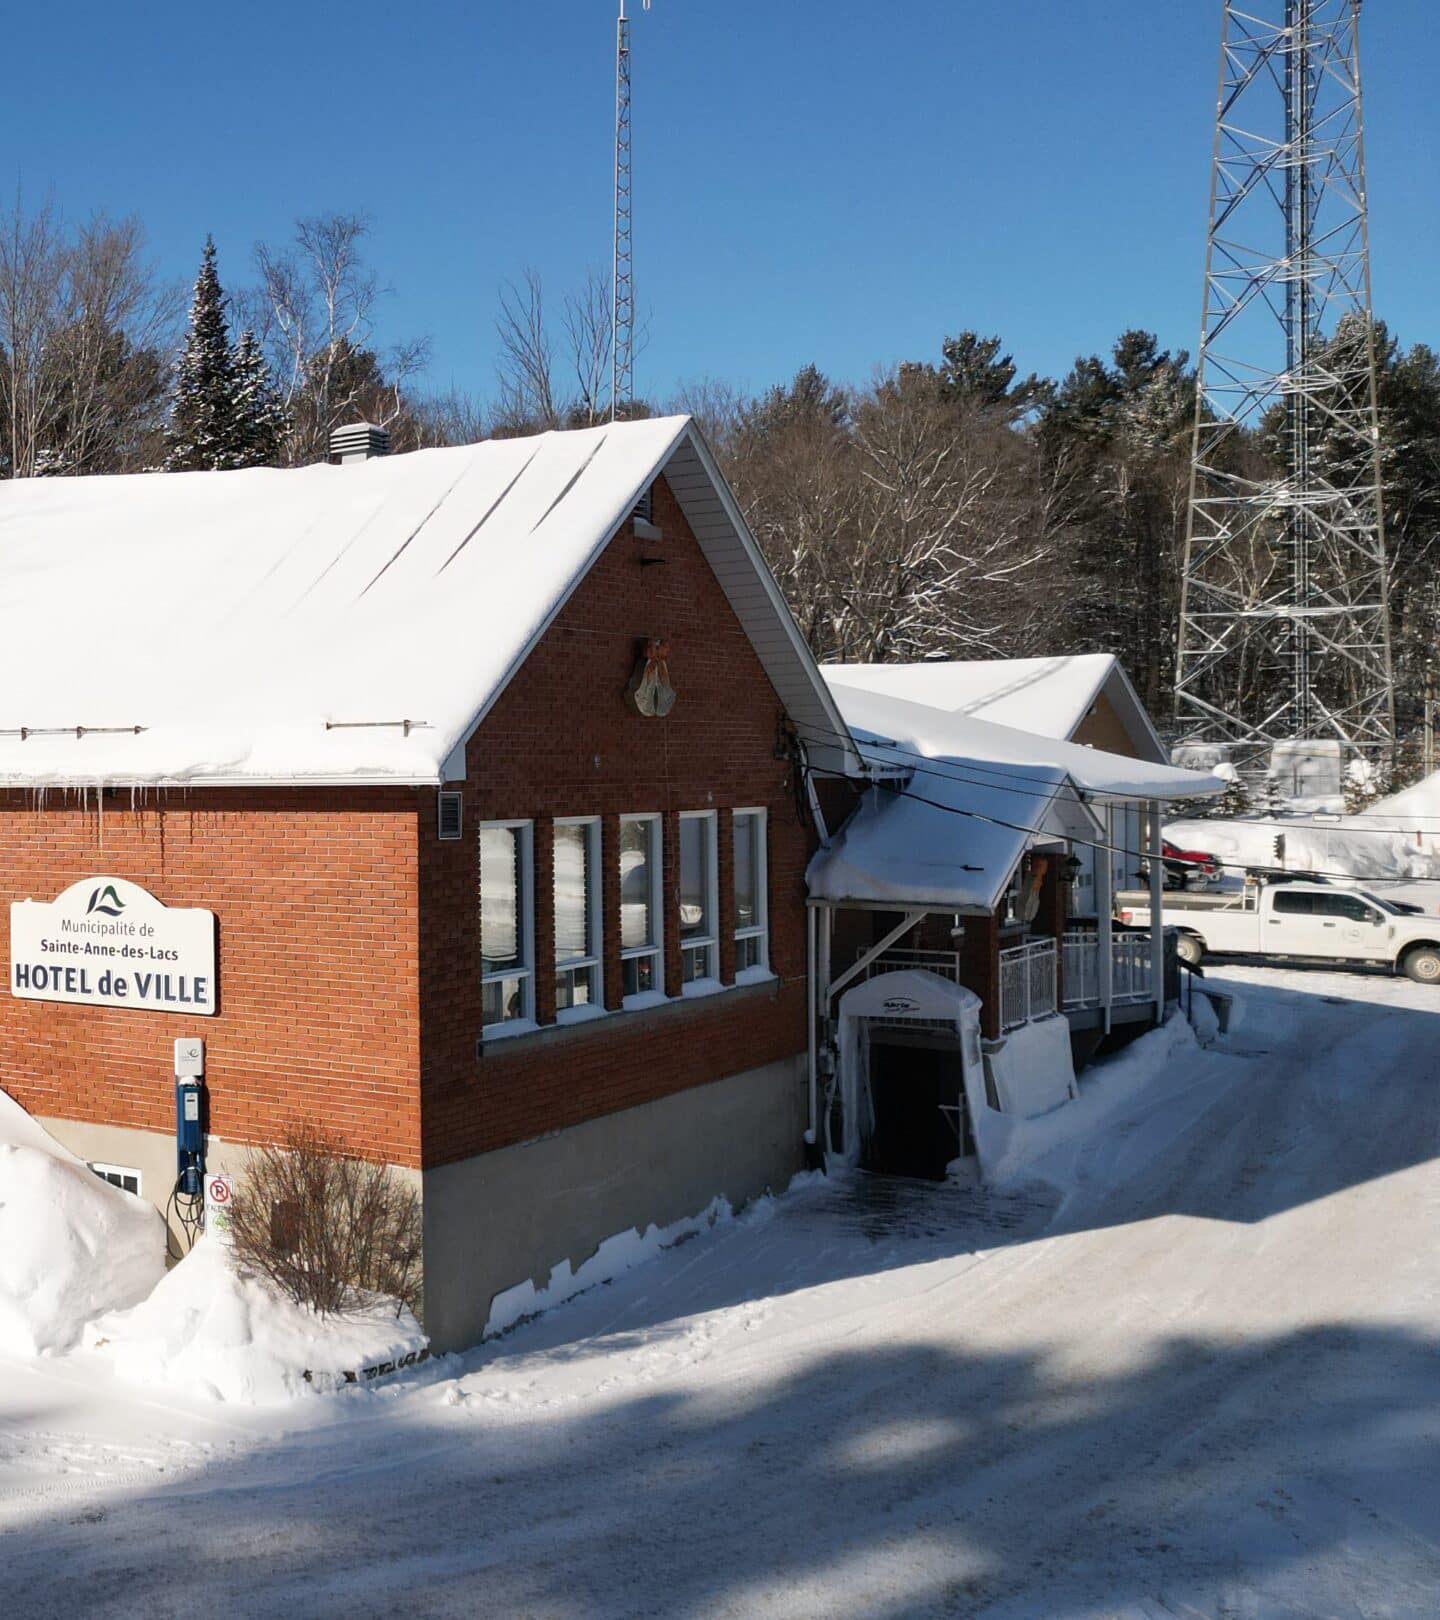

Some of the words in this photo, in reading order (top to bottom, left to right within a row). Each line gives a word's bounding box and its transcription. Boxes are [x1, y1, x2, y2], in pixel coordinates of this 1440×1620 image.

[61, 919, 136, 938] Municipalité
[139, 922, 155, 937] de
[41, 938, 179, 961] Sainte-Anne-des-Lacs
[15, 963, 92, 994] HOTEL
[98, 969, 128, 997] de
[134, 972, 208, 1004] VILLE
